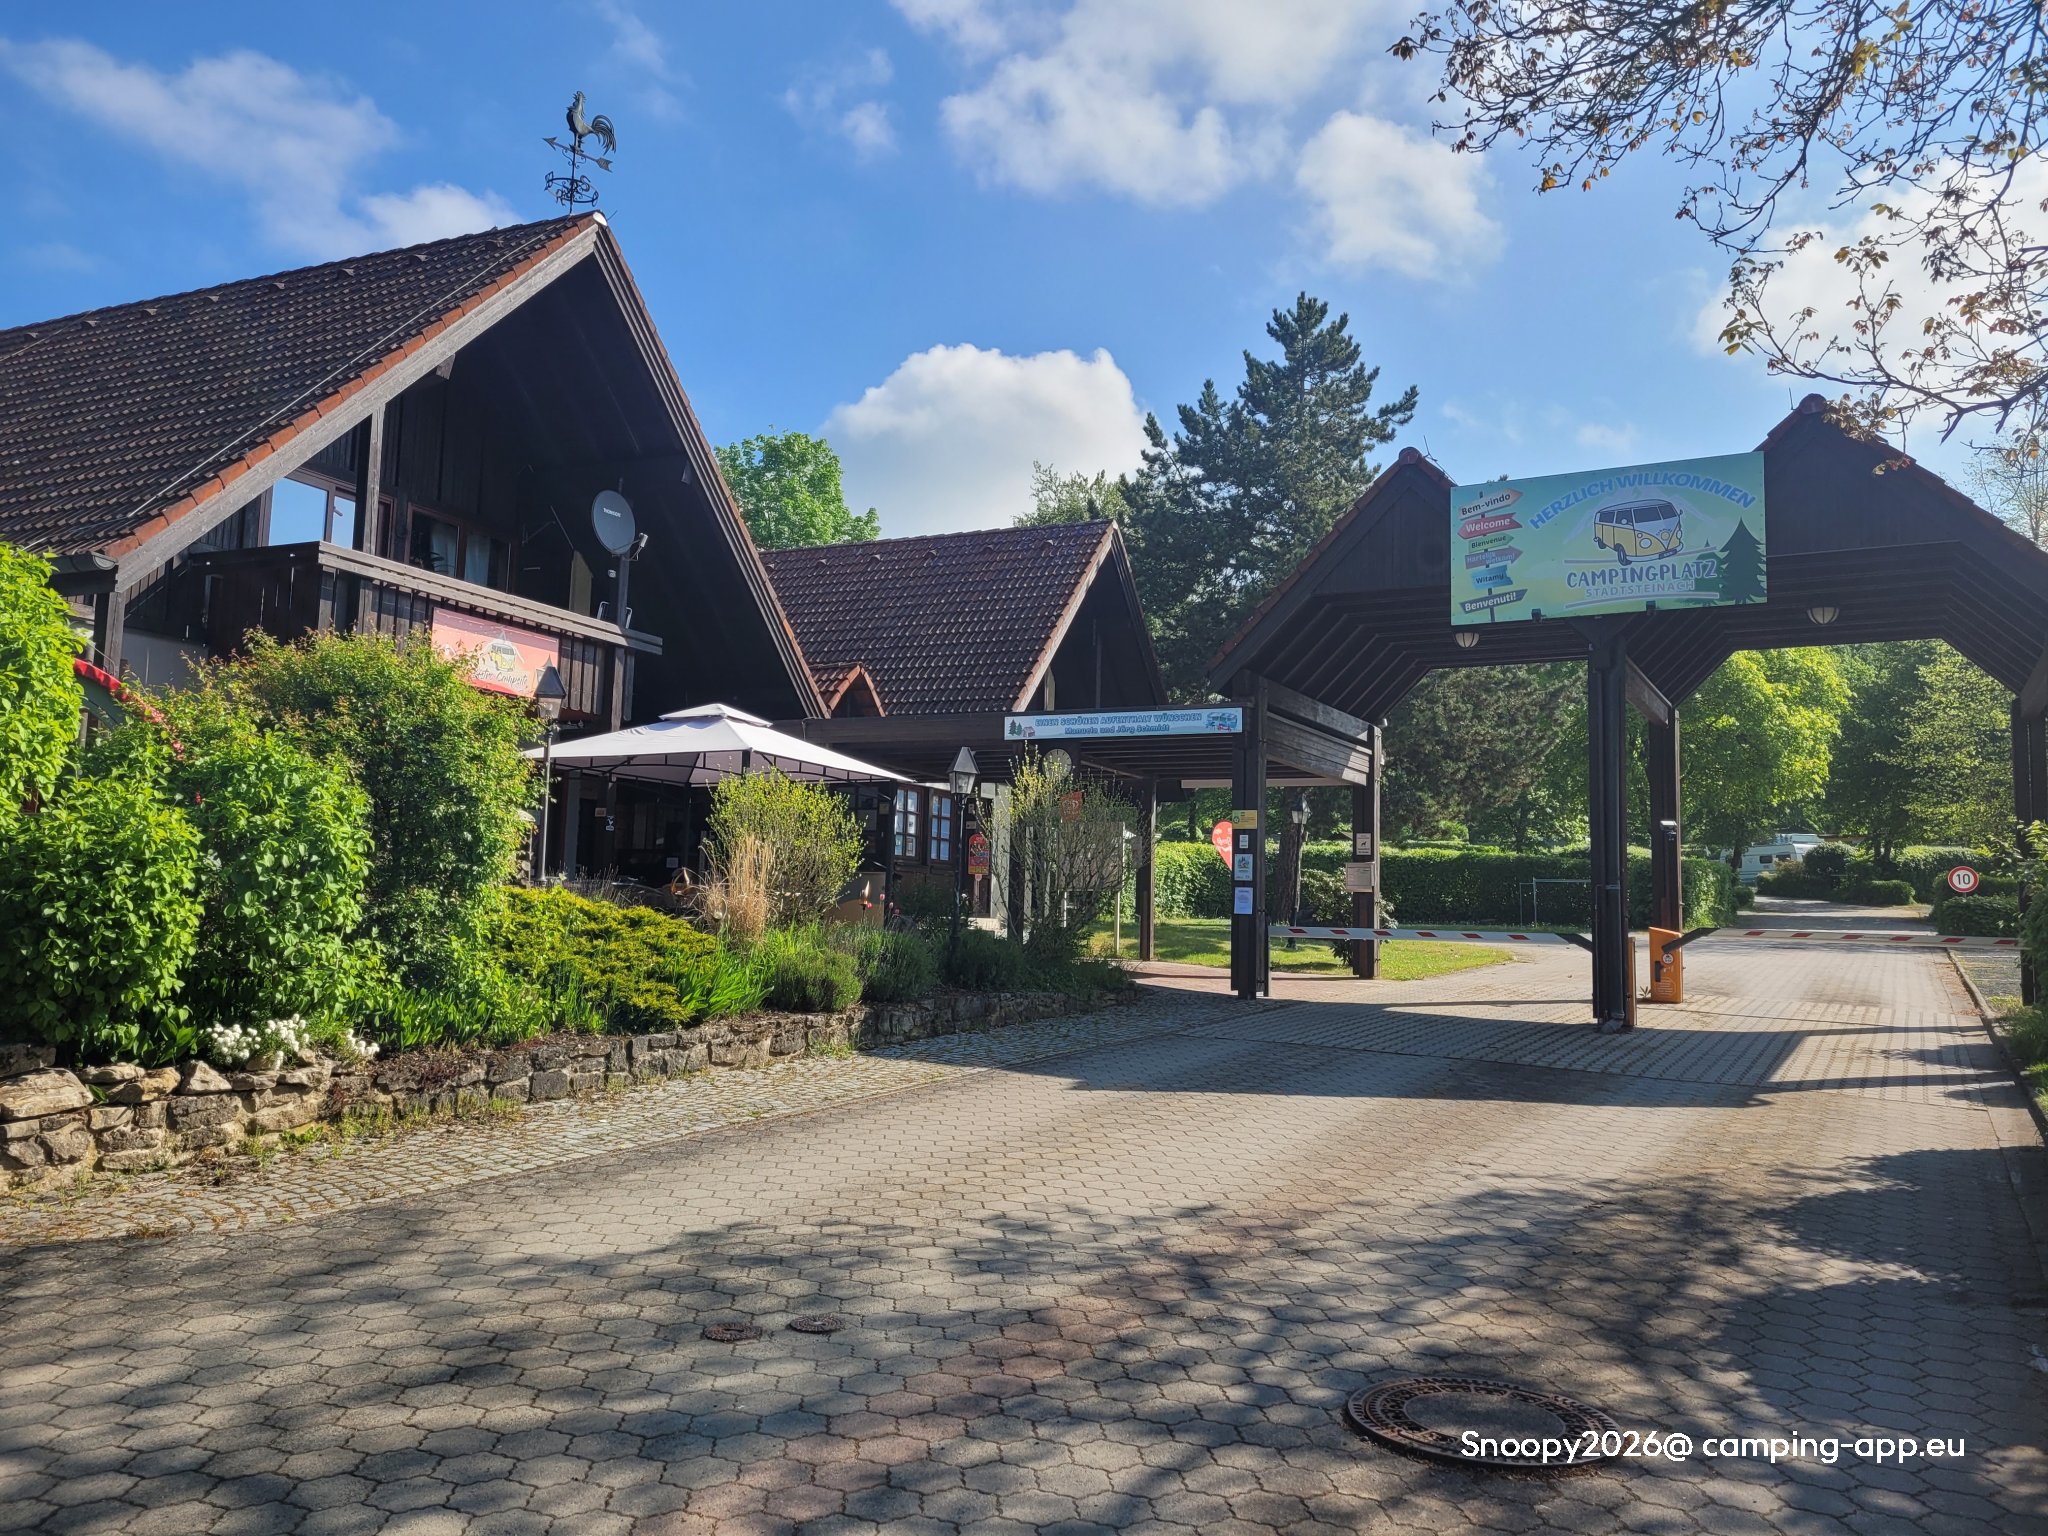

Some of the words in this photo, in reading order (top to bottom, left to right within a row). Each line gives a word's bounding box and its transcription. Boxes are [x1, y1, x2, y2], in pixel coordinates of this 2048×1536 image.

[1461, 493, 1511, 516] Bem-vindo
[1529, 479, 1613, 529] HERZLICH
[1616, 472, 1756, 508] WILLKOMMEN
[1466, 518, 1510, 533] Welcome
[1471, 535, 1507, 549] Bienvenue
[1567, 560, 1717, 588] CAMPINGPLATZ
[1586, 580, 1695, 598] STADTSTEINACH
[1465, 592, 1516, 611] Benvenuti!
[1035, 718, 1059, 727] EINEN
[1060, 715, 1099, 726] SCHÖNEN
[1101, 713, 1152, 725] AUFENTHALT
[1152, 711, 1202, 724] WÜNSCHEN
[1100, 725, 1115, 734] und
[1116, 724, 1135, 734] Jörg
[1136, 722, 1170, 733] Schmidt
[1956, 873, 1971, 886] 10
